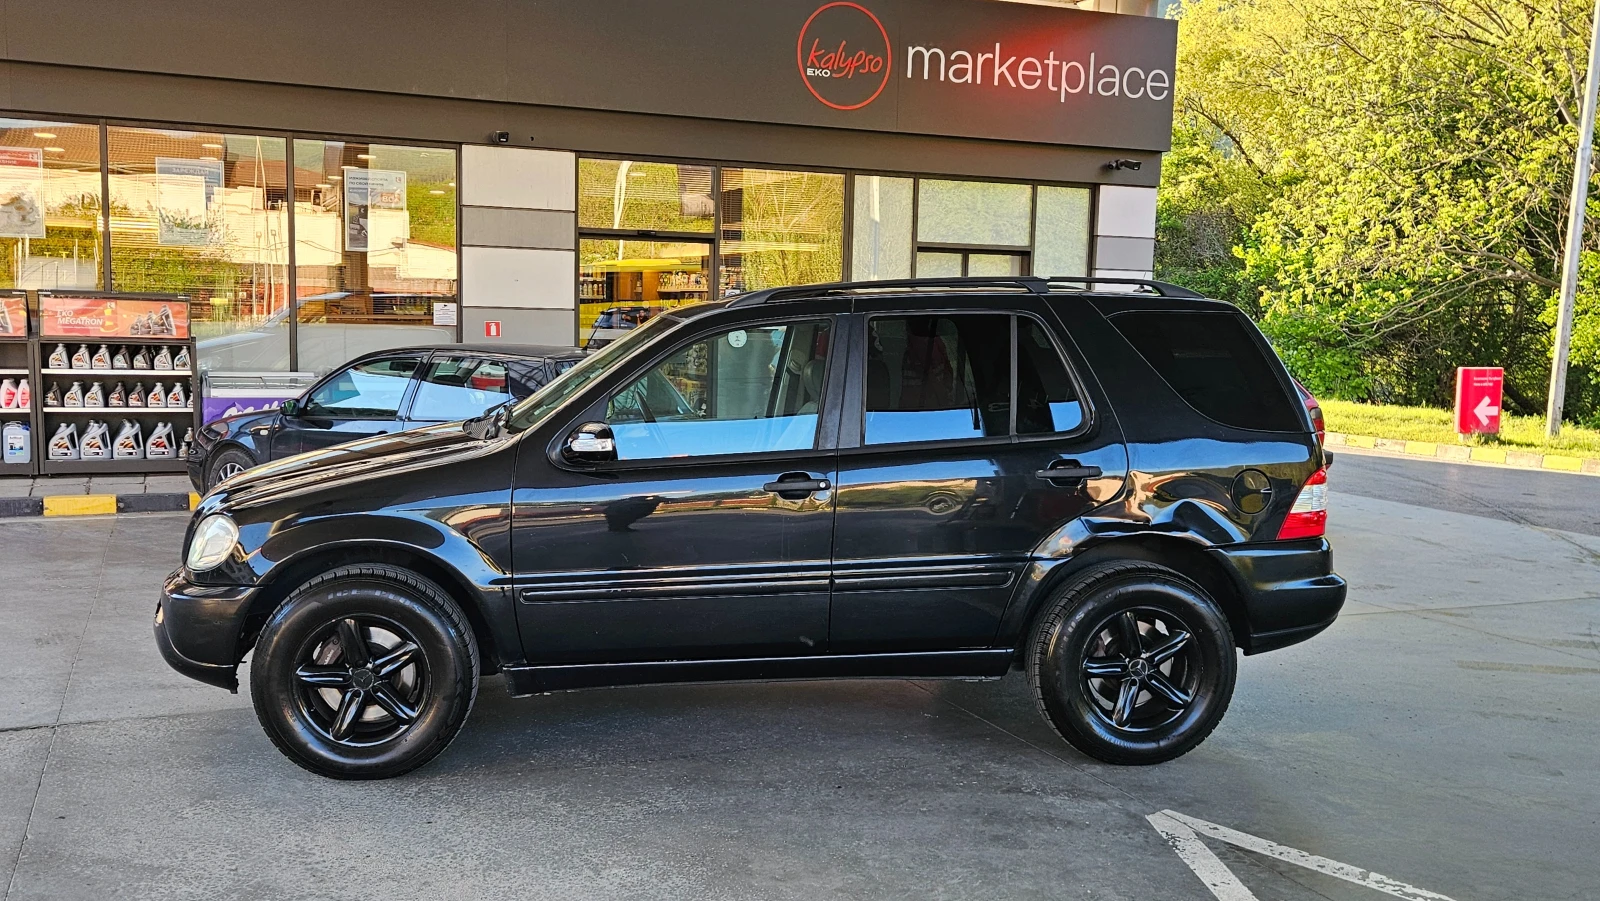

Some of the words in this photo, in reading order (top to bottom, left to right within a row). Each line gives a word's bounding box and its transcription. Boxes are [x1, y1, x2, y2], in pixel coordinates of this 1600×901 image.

[808, 38, 883, 79] kalypso
[806, 68, 831, 77] EKO
[907, 43, 1170, 102] marketplace
[57, 317, 103, 326] MEGATRON
